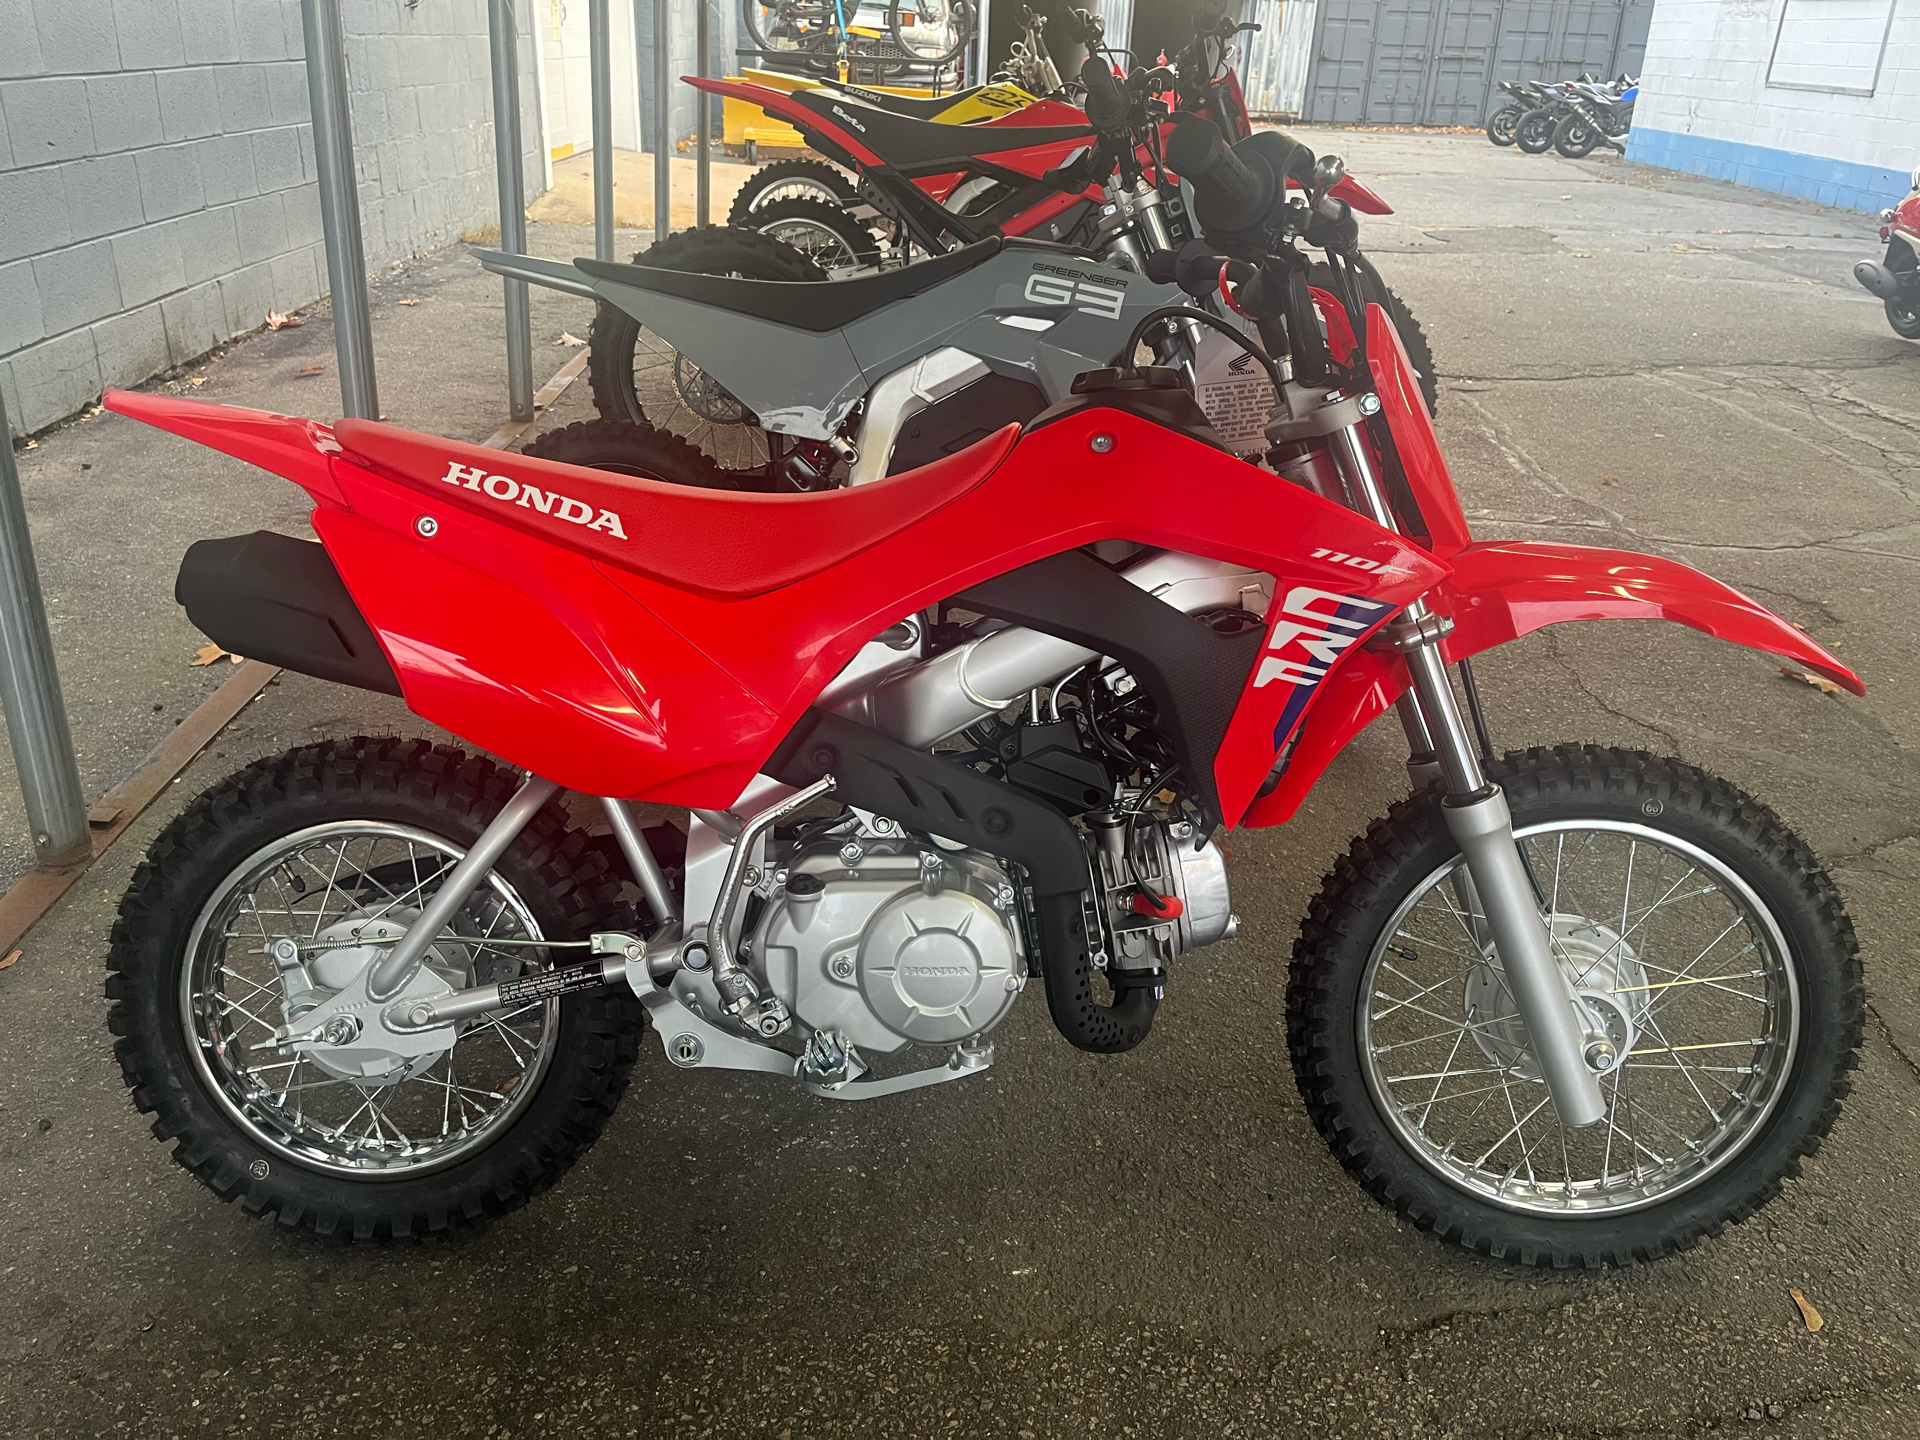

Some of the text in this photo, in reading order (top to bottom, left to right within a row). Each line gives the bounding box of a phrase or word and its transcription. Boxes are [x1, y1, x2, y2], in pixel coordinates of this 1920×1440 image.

[844, 85, 882, 102] SUZUKI
[832, 105, 866, 133] Beta
[1032, 262, 1129, 288] GREENGER
[1024, 274, 1126, 320] G3
[441, 461, 628, 540] HONDA
[1310, 547, 1417, 575] 110F
[1253, 586, 1384, 688] CRF
[903, 966, 972, 977] HONDA
